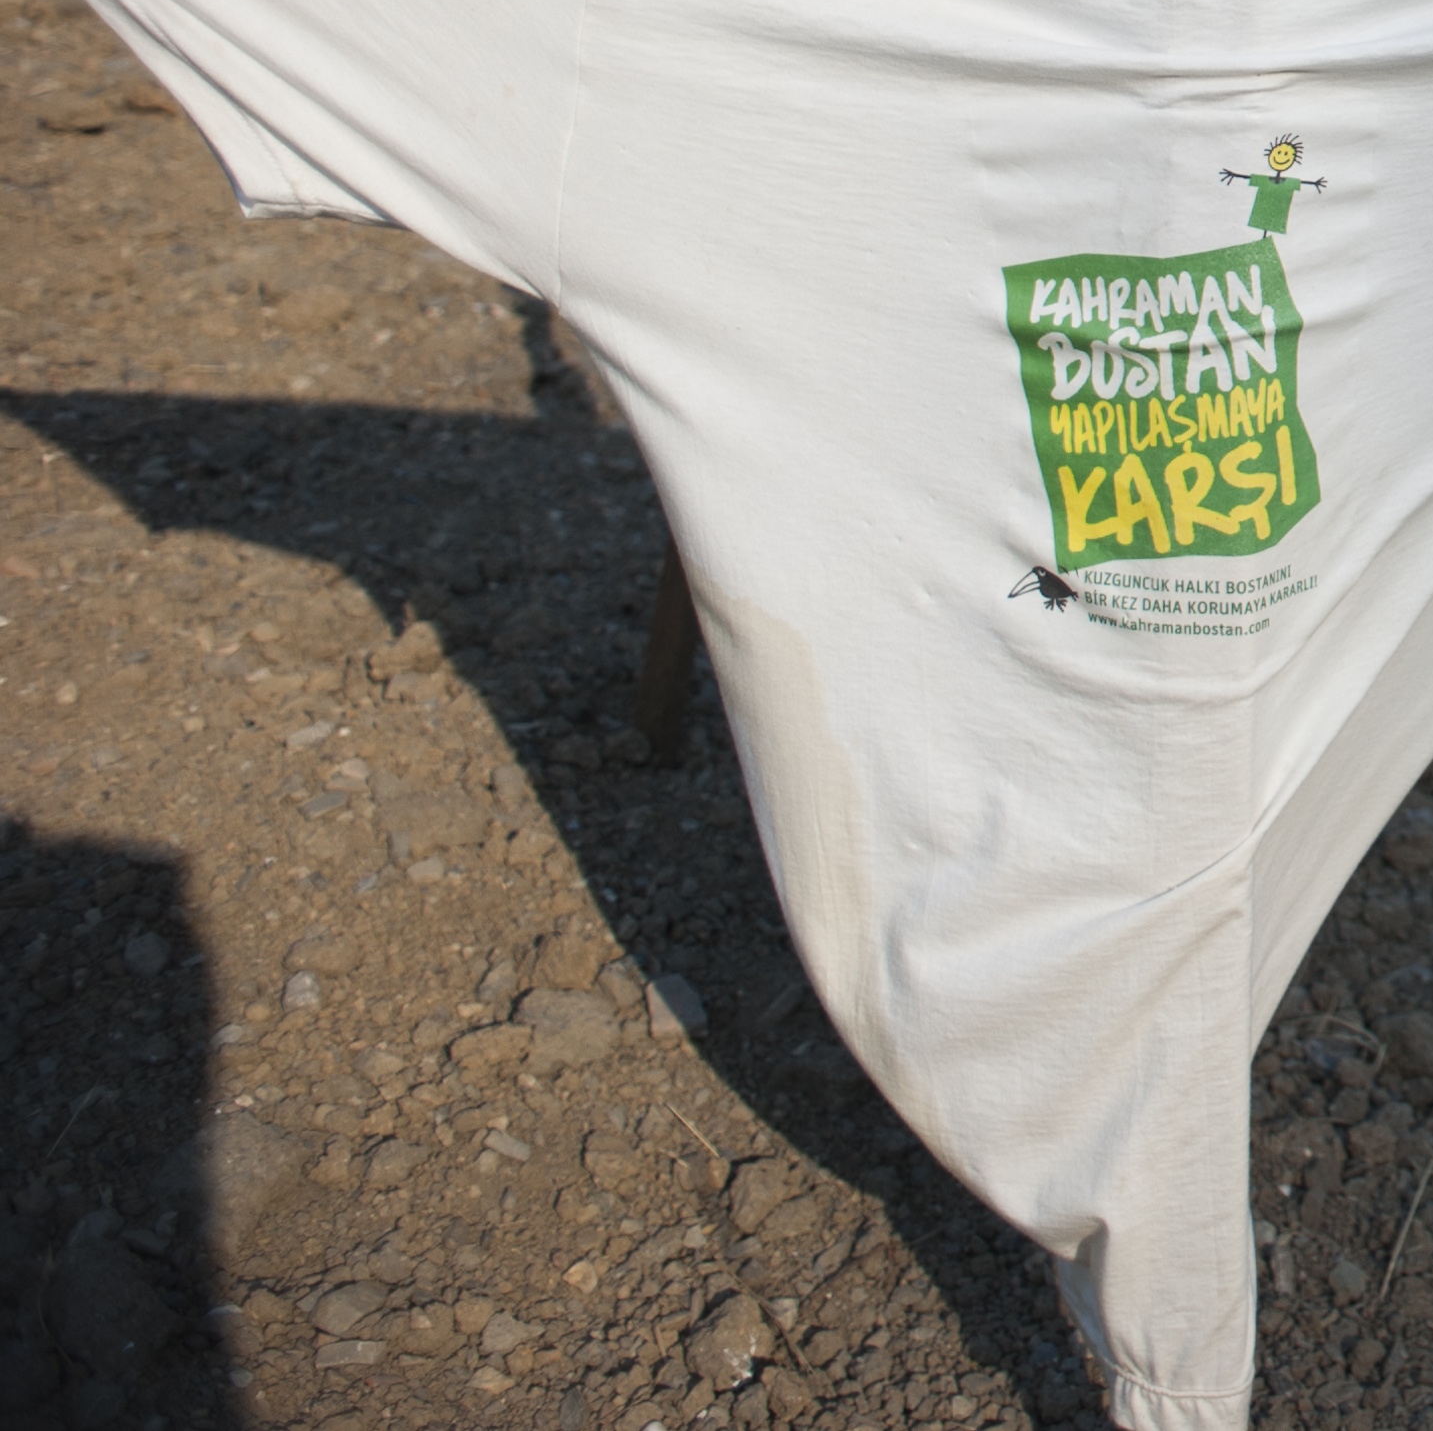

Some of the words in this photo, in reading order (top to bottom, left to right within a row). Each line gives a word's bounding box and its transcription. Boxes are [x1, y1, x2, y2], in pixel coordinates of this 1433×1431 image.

[1029, 264, 1264, 333] KAHRAMAN
[1037, 305, 1278, 401] BOSTAN
[1050, 377, 1286, 456] YAPILAŞMAYA
[1057, 425, 1297, 554] KARŞI
[1084, 570, 1170, 593] KUZGUNCUK
[1174, 579, 1220, 595] HALKI
[1225, 564, 1293, 595] BOSTANINI
[1084, 591, 1107, 607] BİR
[1111, 596, 1138, 611] KEZ
[1142, 597, 1183, 615] DAHA
[1187, 596, 1267, 616] KORUMAYA
[1269, 574, 1319, 607] KARARLI!
[1087, 611, 1271, 637] www.kahramanbostan.com
